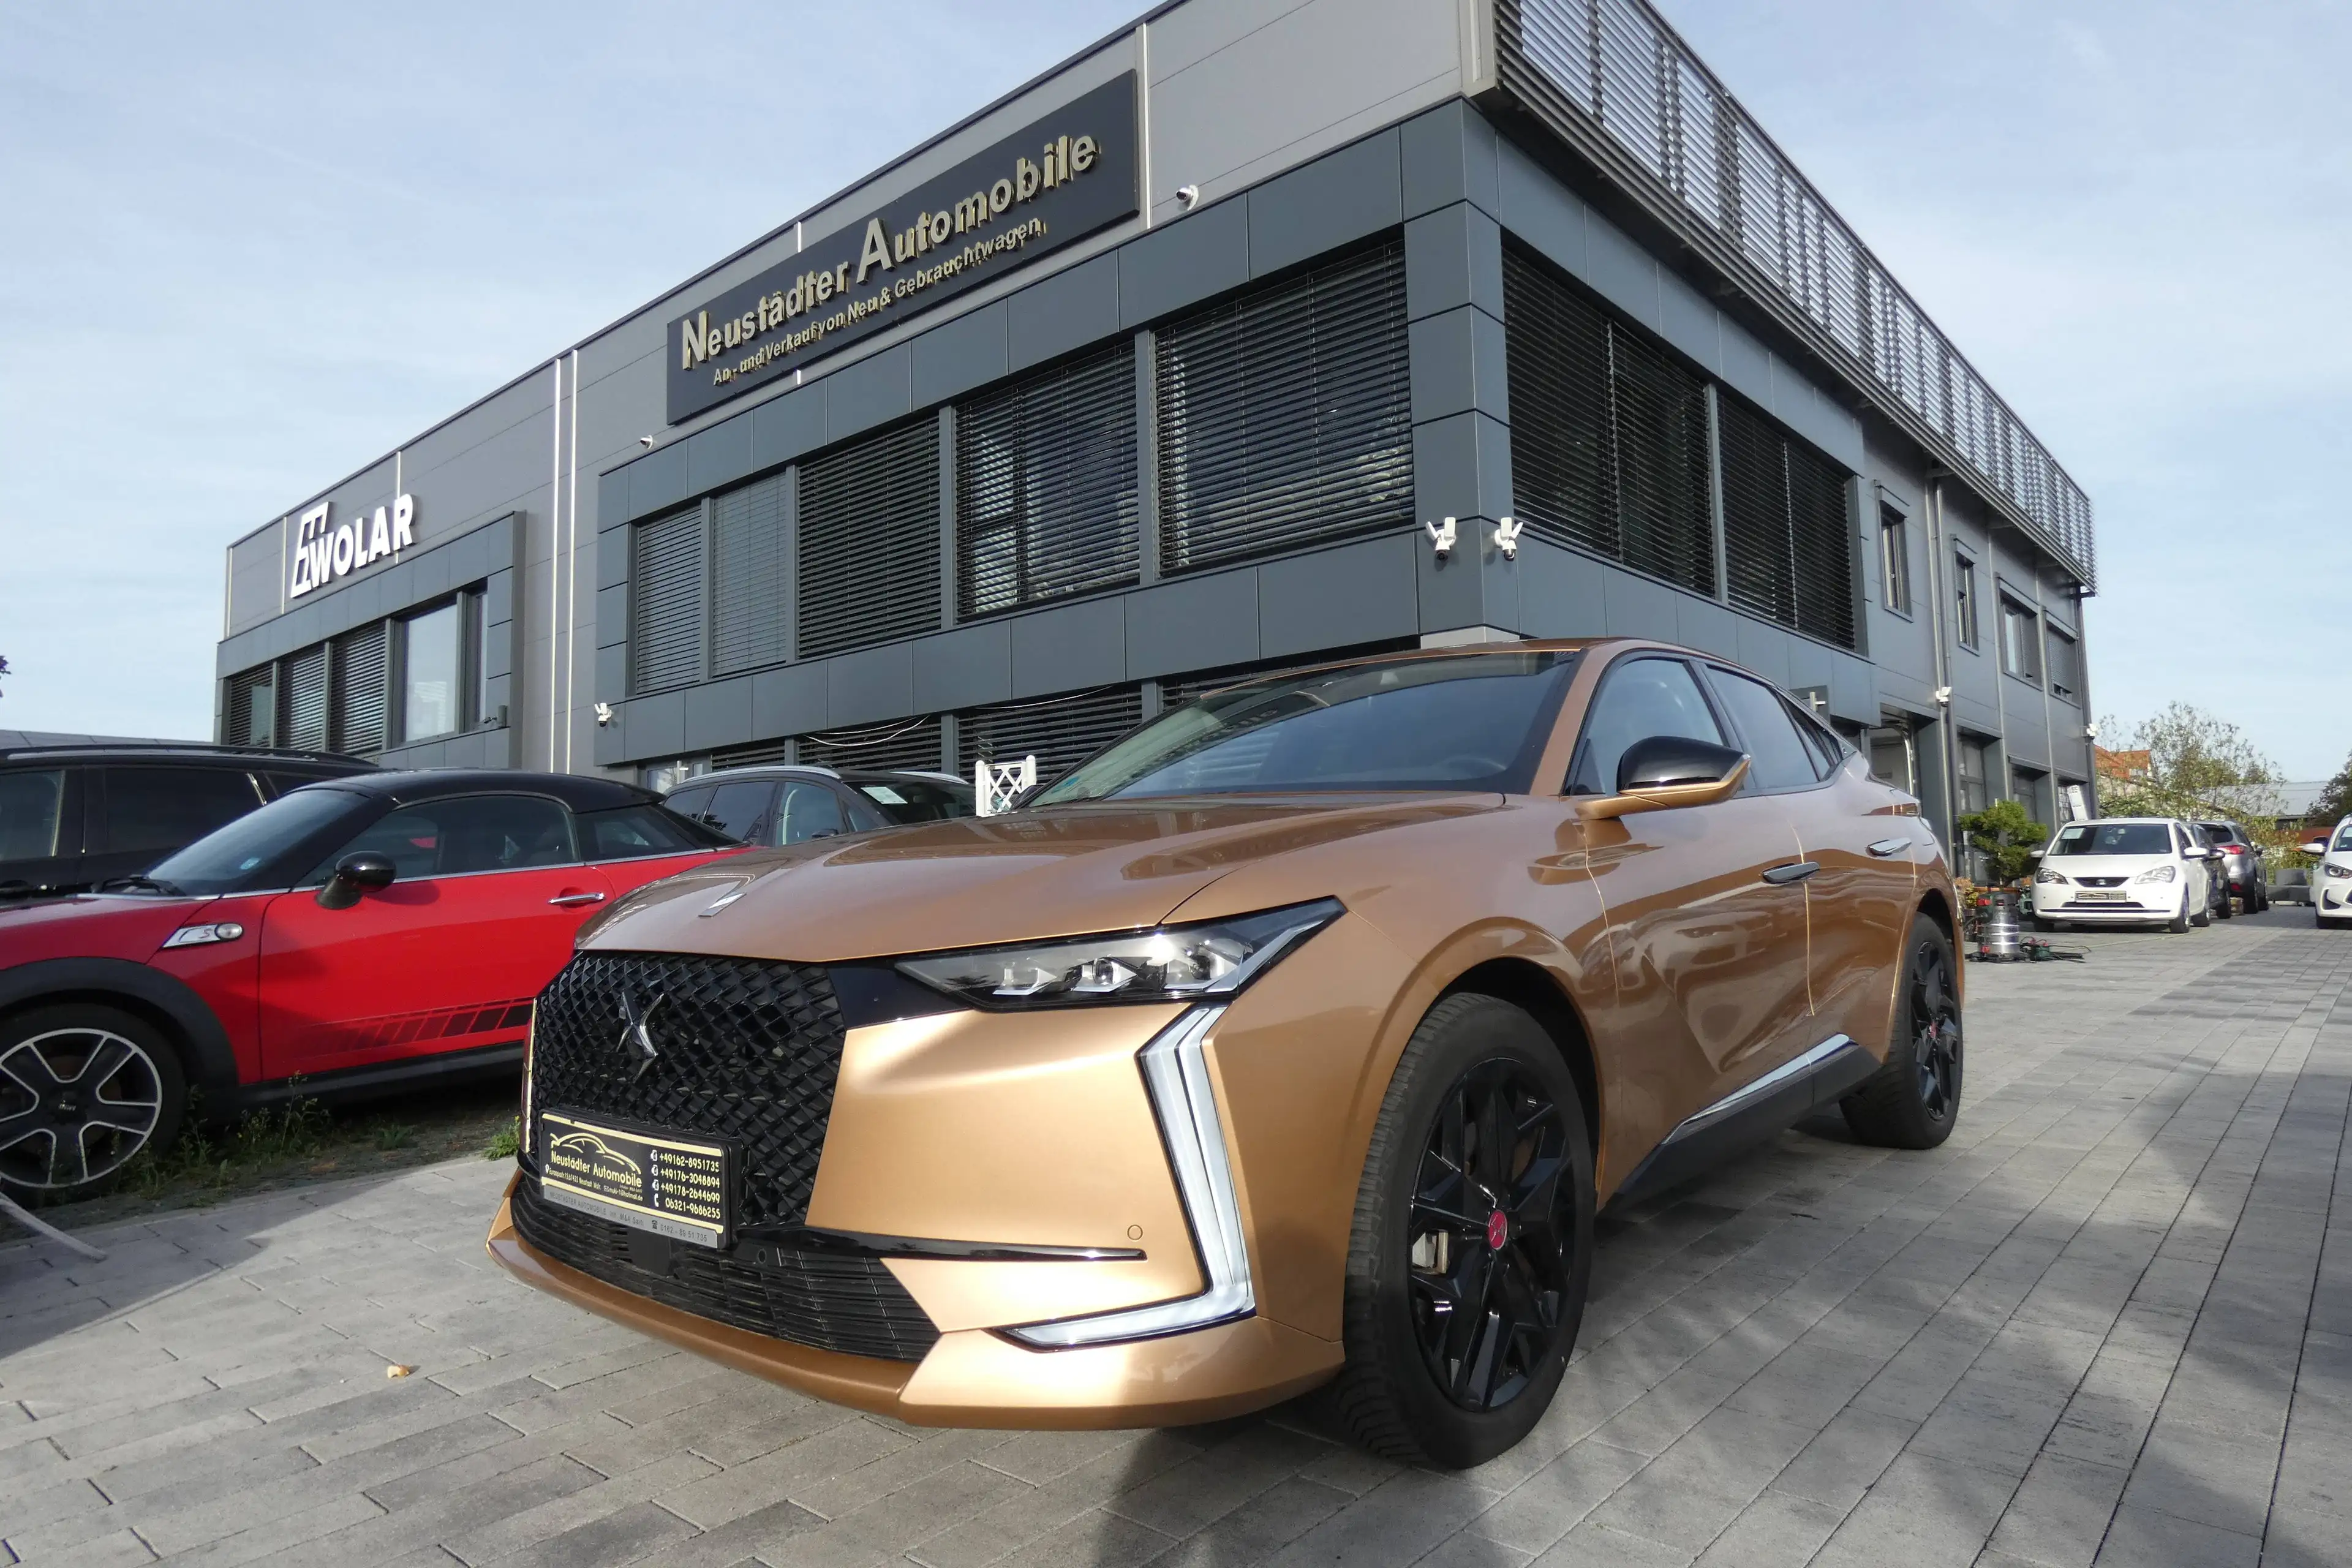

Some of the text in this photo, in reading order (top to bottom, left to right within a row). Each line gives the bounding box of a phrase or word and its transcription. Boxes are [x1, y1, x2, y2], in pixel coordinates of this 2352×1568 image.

[683, 135, 1098, 370] Neustädter Automobile
[740, 347, 766, 372] und
[766, 322, 820, 360] Verkauf
[819, 311, 846, 336] von
[848, 295, 882, 323] Neu
[880, 286, 892, 305] &
[894, 217, 1046, 300] Gebrauchtwagen
[551, 1151, 643, 1188] Neustädter Automobile
[660, 1153, 720, 1173] +49162-8951735
[660, 1169, 720, 1189] +49176-3048894
[660, 1183, 720, 1204] +49178-2644699
[665, 1197, 721, 1219] 06321-9686255
